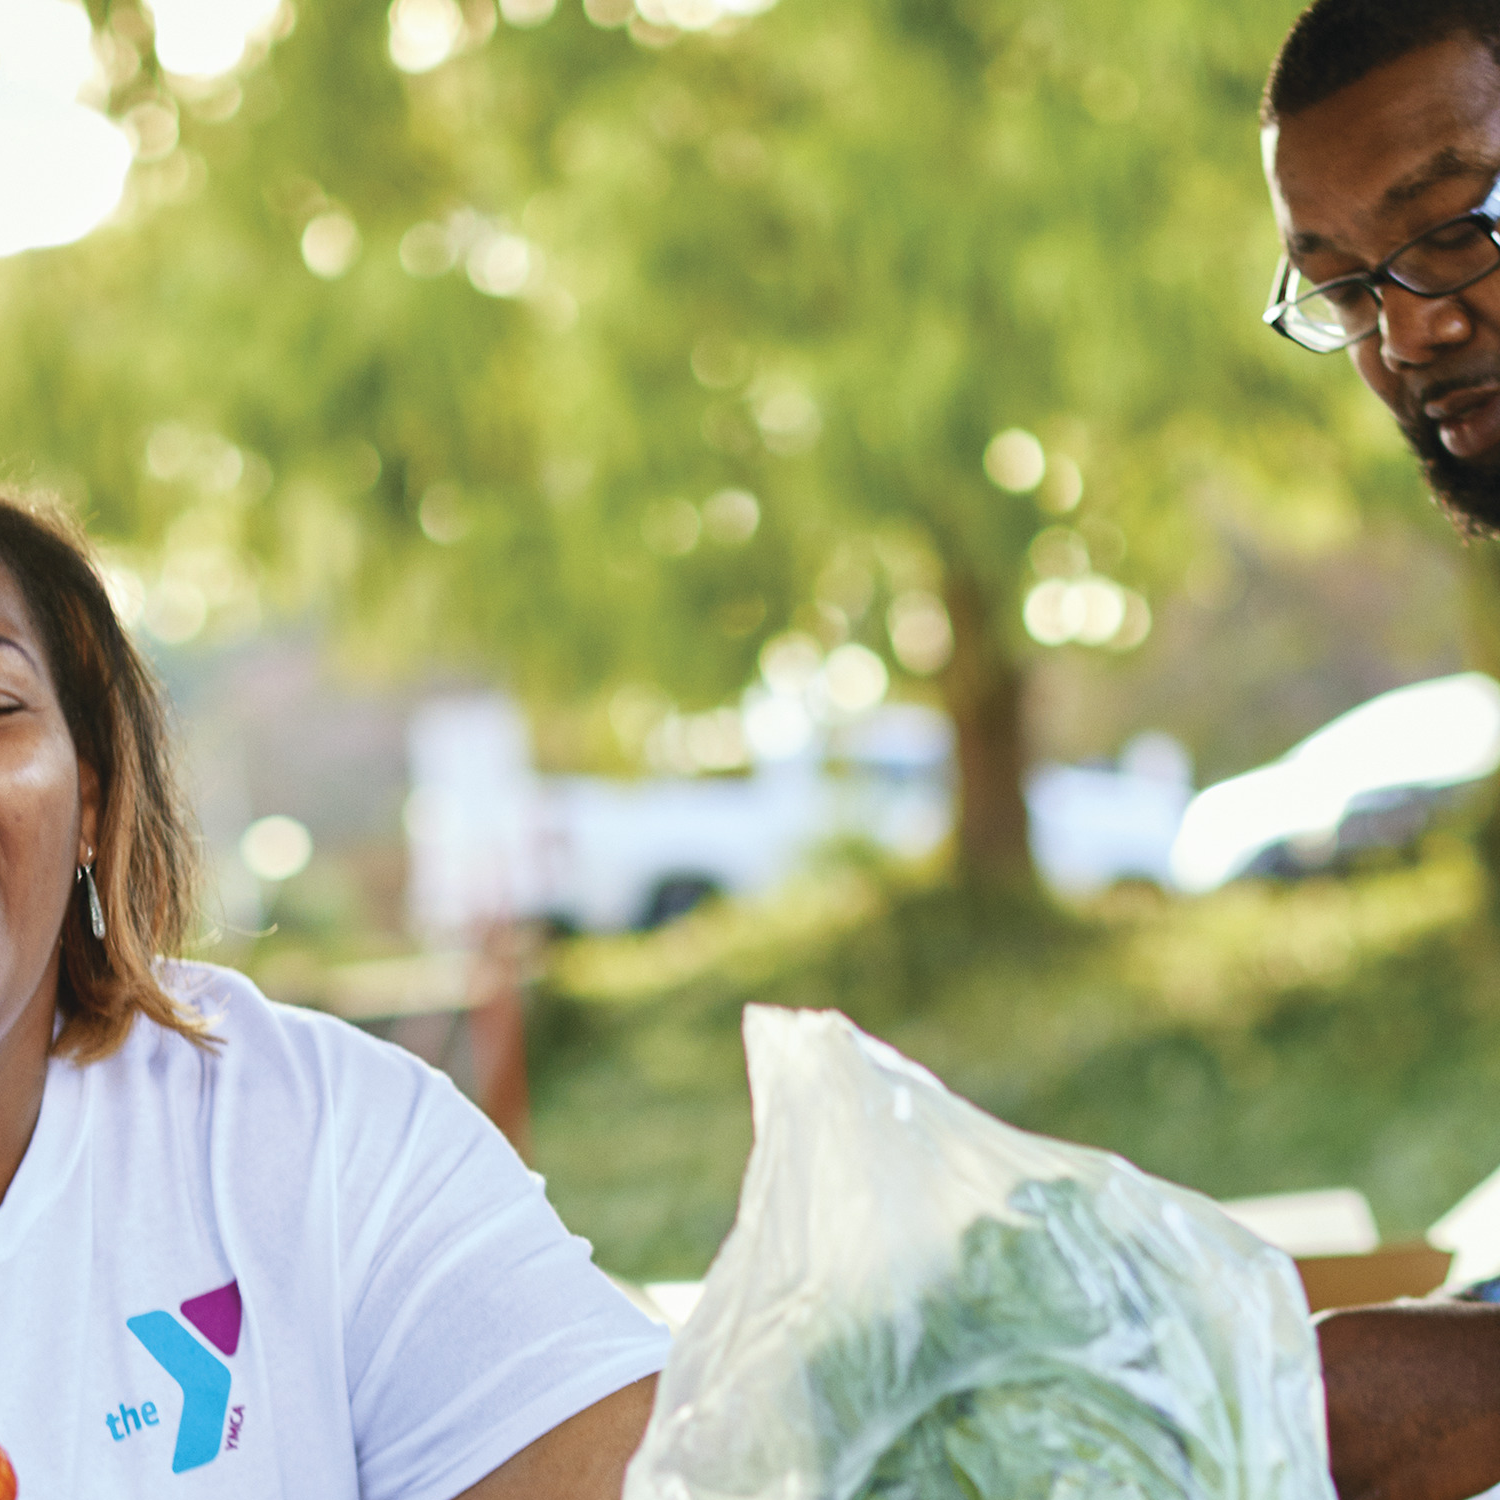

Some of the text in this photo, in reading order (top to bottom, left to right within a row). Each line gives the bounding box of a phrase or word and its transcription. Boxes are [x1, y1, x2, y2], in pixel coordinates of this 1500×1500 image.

[106, 1278, 242, 1474] the Y
[226, 1404, 245, 1451] YMCA
